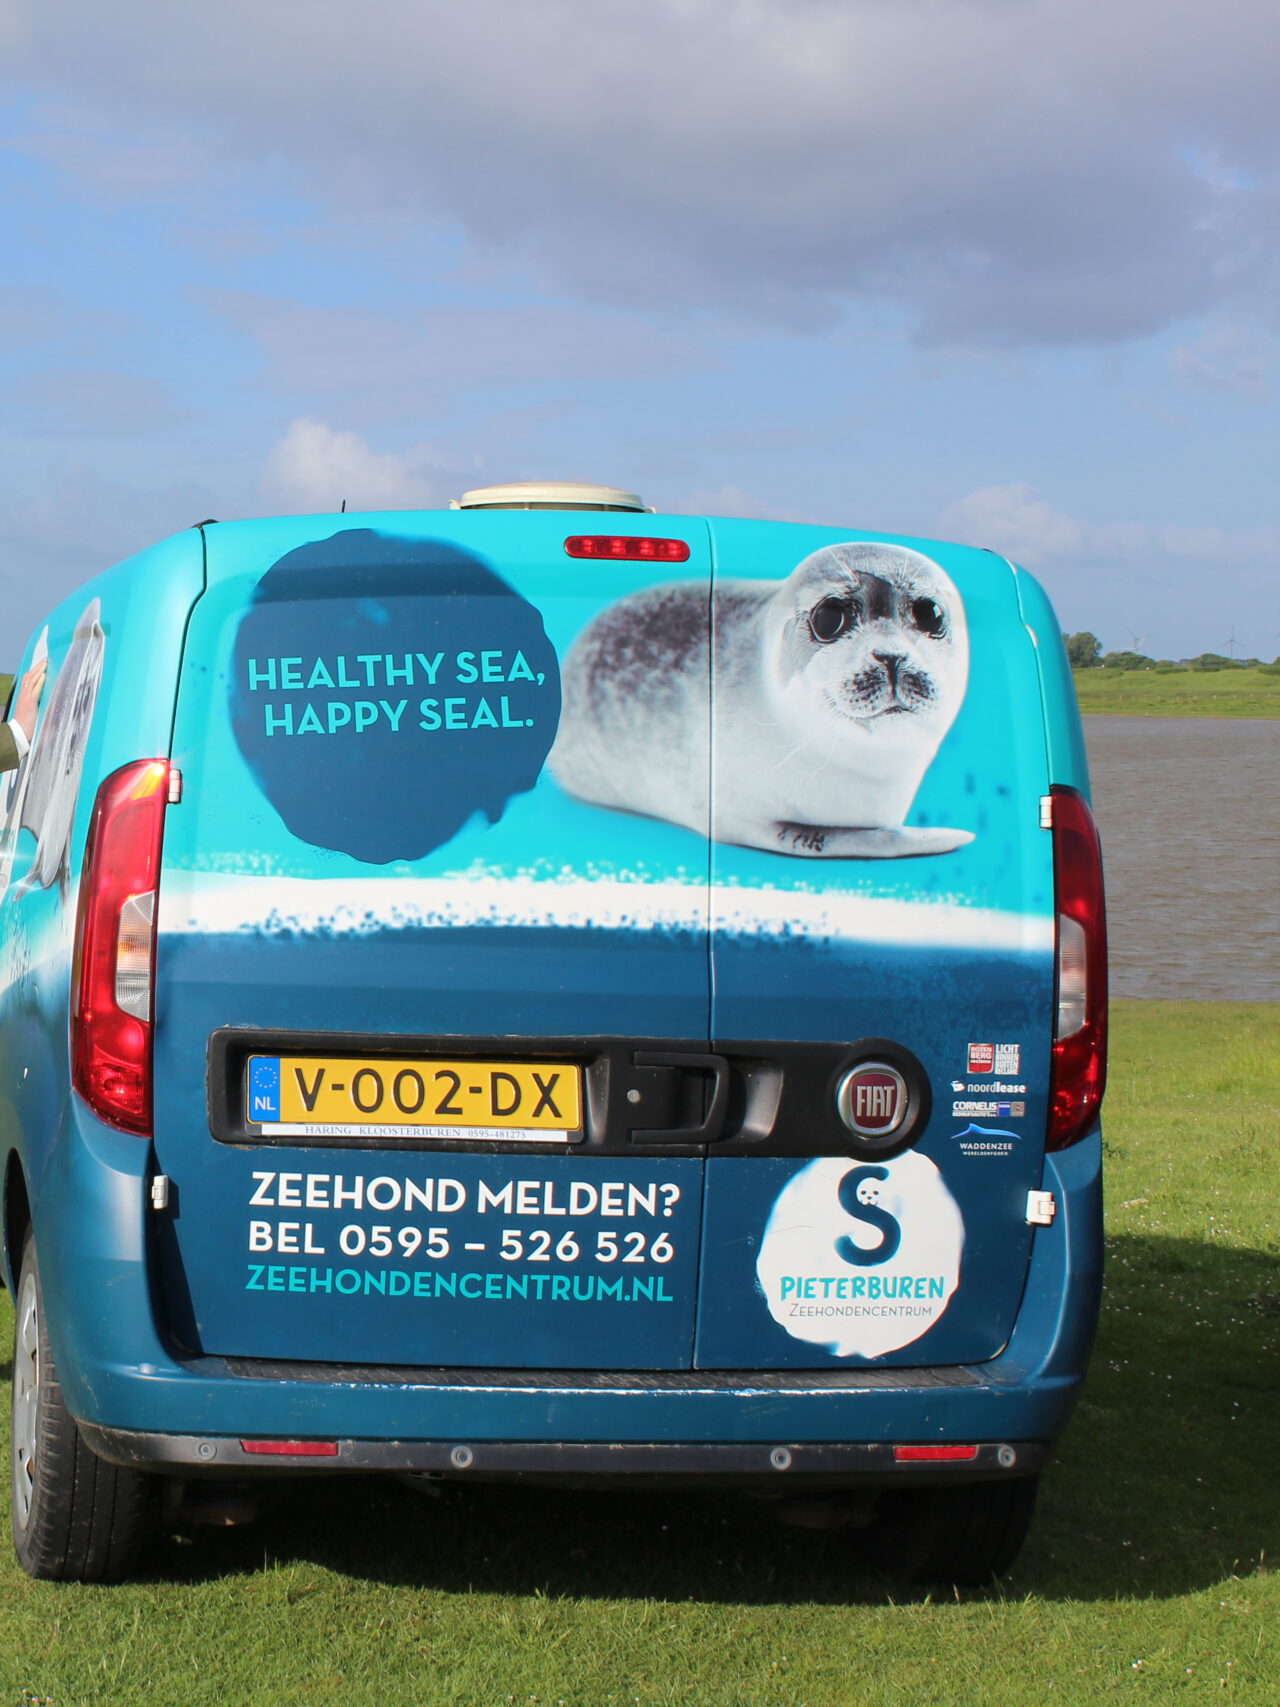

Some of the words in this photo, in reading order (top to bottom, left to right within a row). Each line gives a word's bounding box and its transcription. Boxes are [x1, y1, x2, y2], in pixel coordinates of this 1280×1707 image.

[248, 652, 444, 691] HEALTHY
[456, 650, 545, 686] SEA,
[265, 699, 408, 736] HAPPY
[419, 696, 534, 731] SEAL.
[995, 1044, 1020, 1054] LICHT
[294, 1068, 563, 1118] V-002-DX
[967, 1081, 1026, 1093] noordlease
[255, 1096, 276, 1111] NL
[856, 1085, 895, 1117] FIAT
[952, 1101, 997, 1111] CORNELIS
[305, 1126, 352, 1135] HARING
[359, 1126, 461, 1137] KLOOSTERBUREN
[468, 1129, 526, 1139] 0595-481275
[960, 1142, 1013, 1150] WADDENZEE
[249, 1171, 466, 1213] ZEEHOND
[477, 1179, 681, 1218] MELDEN?
[249, 1221, 325, 1254] BEL
[339, 1224, 450, 1259] 0595
[499, 1229, 580, 1262] 526
[595, 1231, 674, 1263] 526
[245, 1264, 674, 1302] ZEEHONDENCENTRUM.NL
[780, 1276, 944, 1301] PIETERBUREN
[789, 1303, 932, 1317] ZEEHONDENCENTRUM
